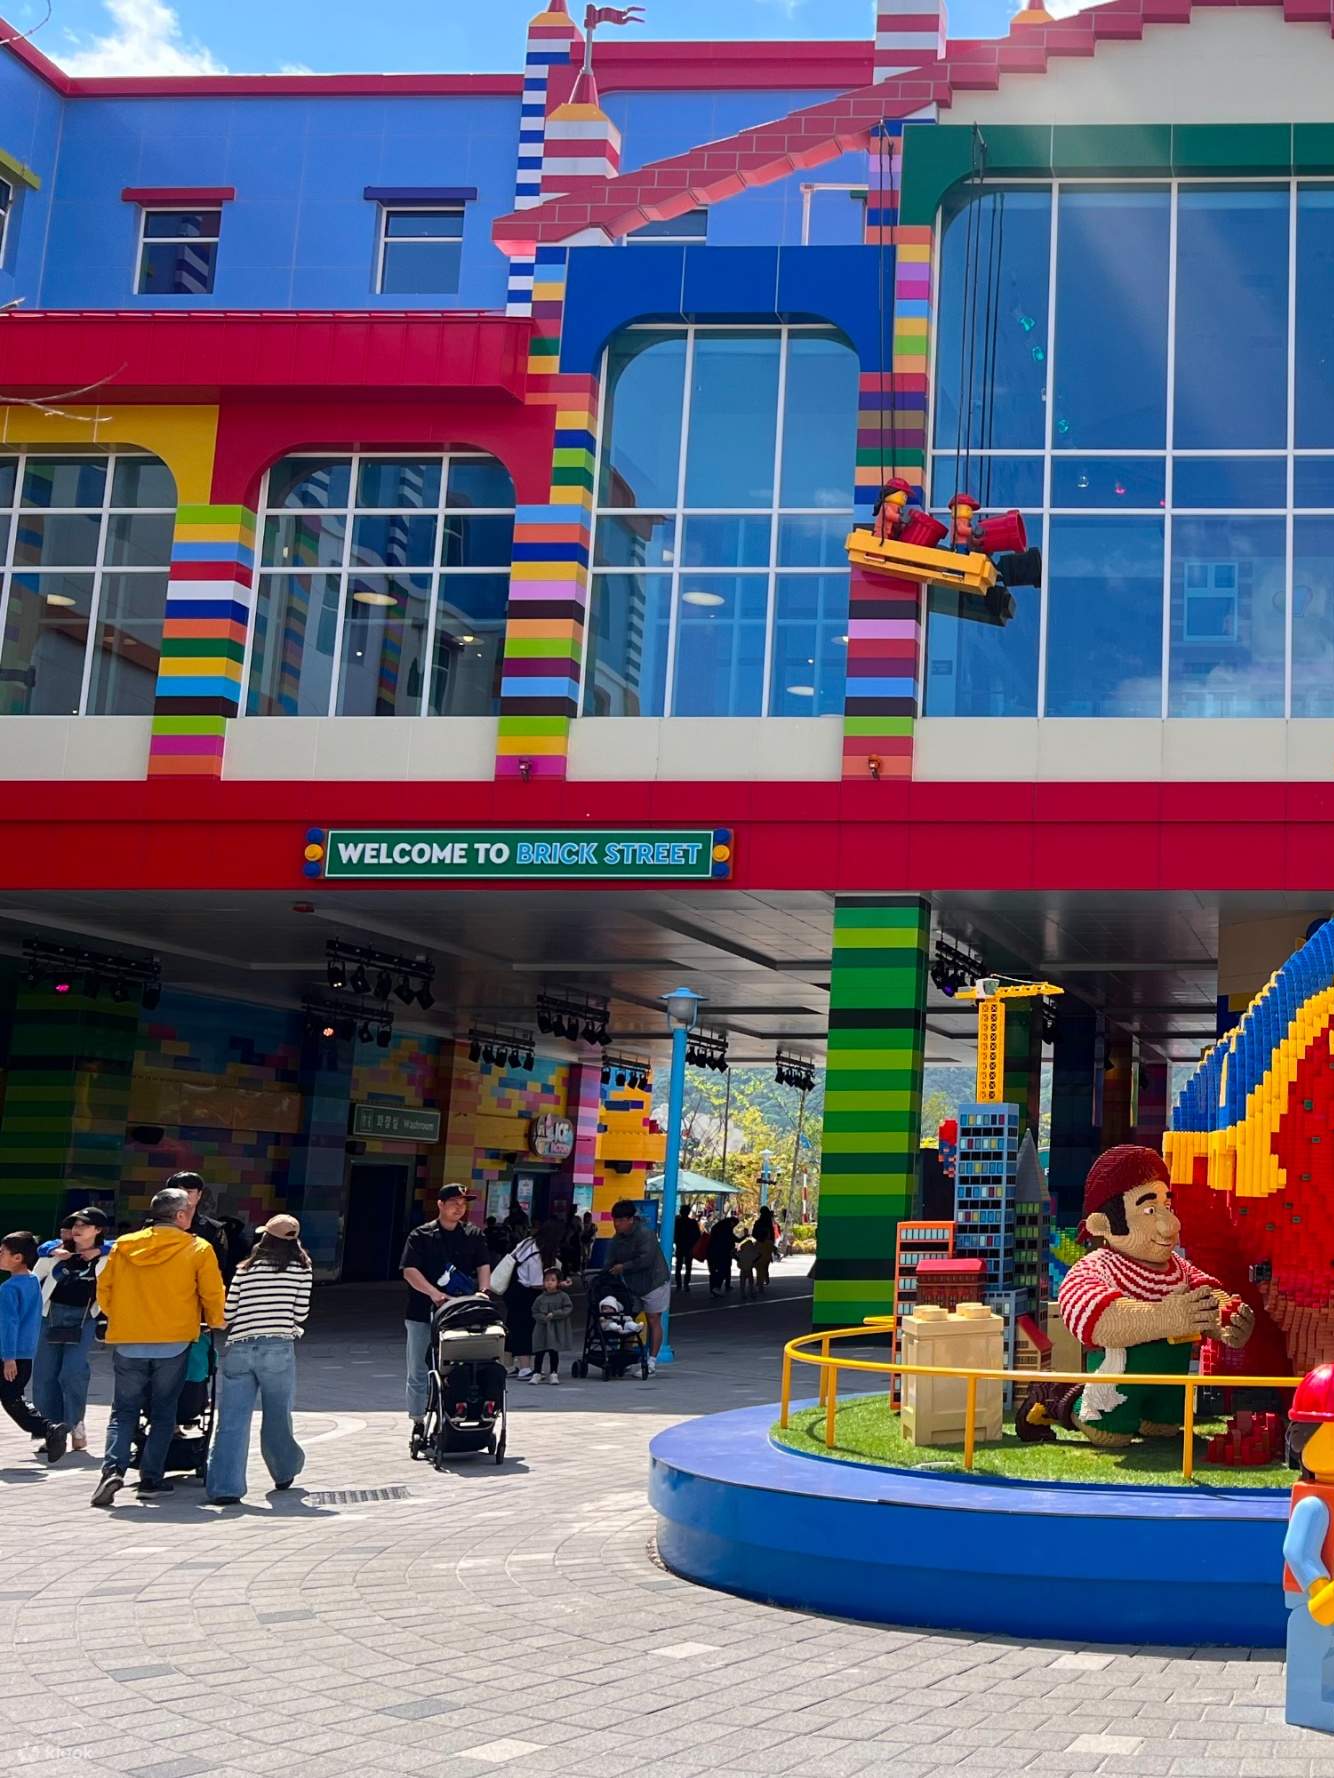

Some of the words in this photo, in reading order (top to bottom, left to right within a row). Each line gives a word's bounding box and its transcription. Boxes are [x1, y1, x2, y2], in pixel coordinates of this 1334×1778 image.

[338, 843, 467, 864] WELCOME
[474, 843, 509, 864] TO
[516, 842, 598, 864] BRICK
[604, 842, 702, 864] STREET
